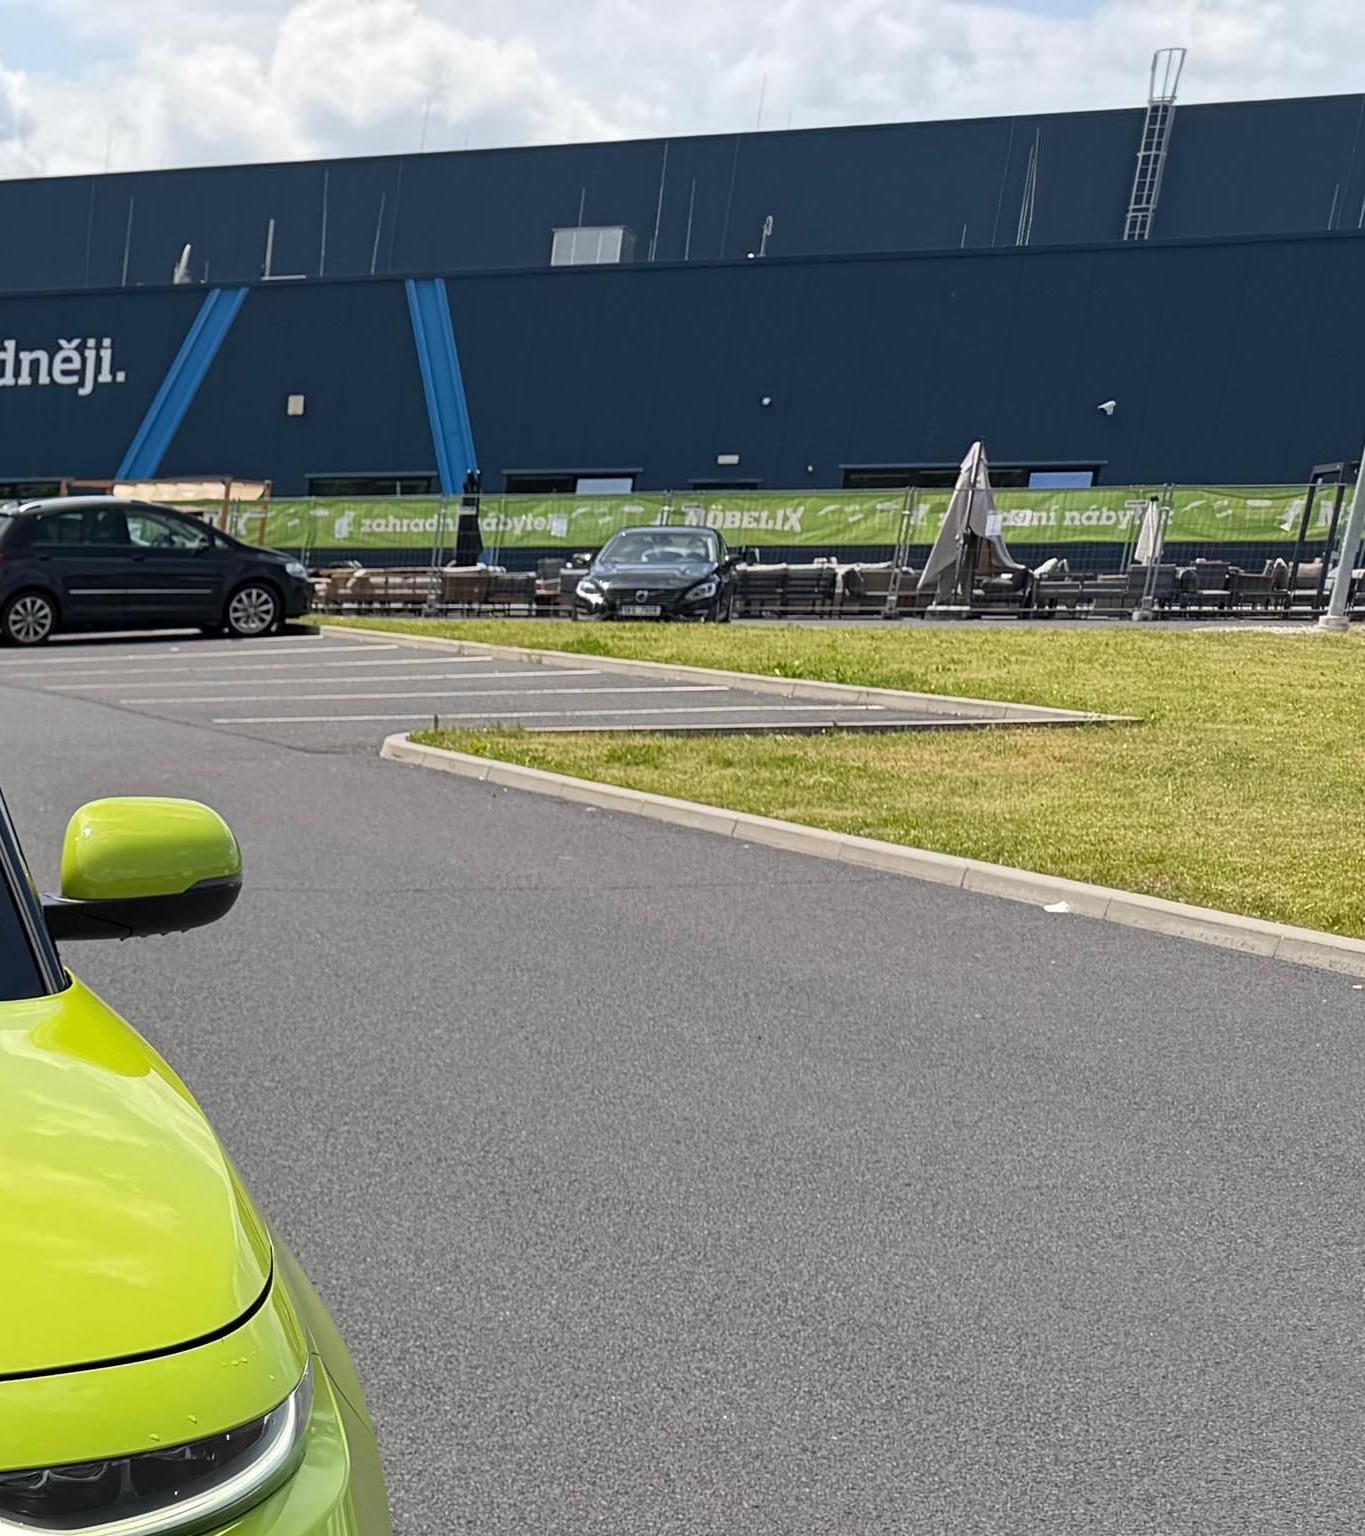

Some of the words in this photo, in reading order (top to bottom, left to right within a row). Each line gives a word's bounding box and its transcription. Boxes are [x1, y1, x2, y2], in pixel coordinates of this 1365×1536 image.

[477, 509, 561, 536] ábyte
[683, 504, 806, 533] MÖBELIX
[1062, 505, 1174, 530] nábyt
